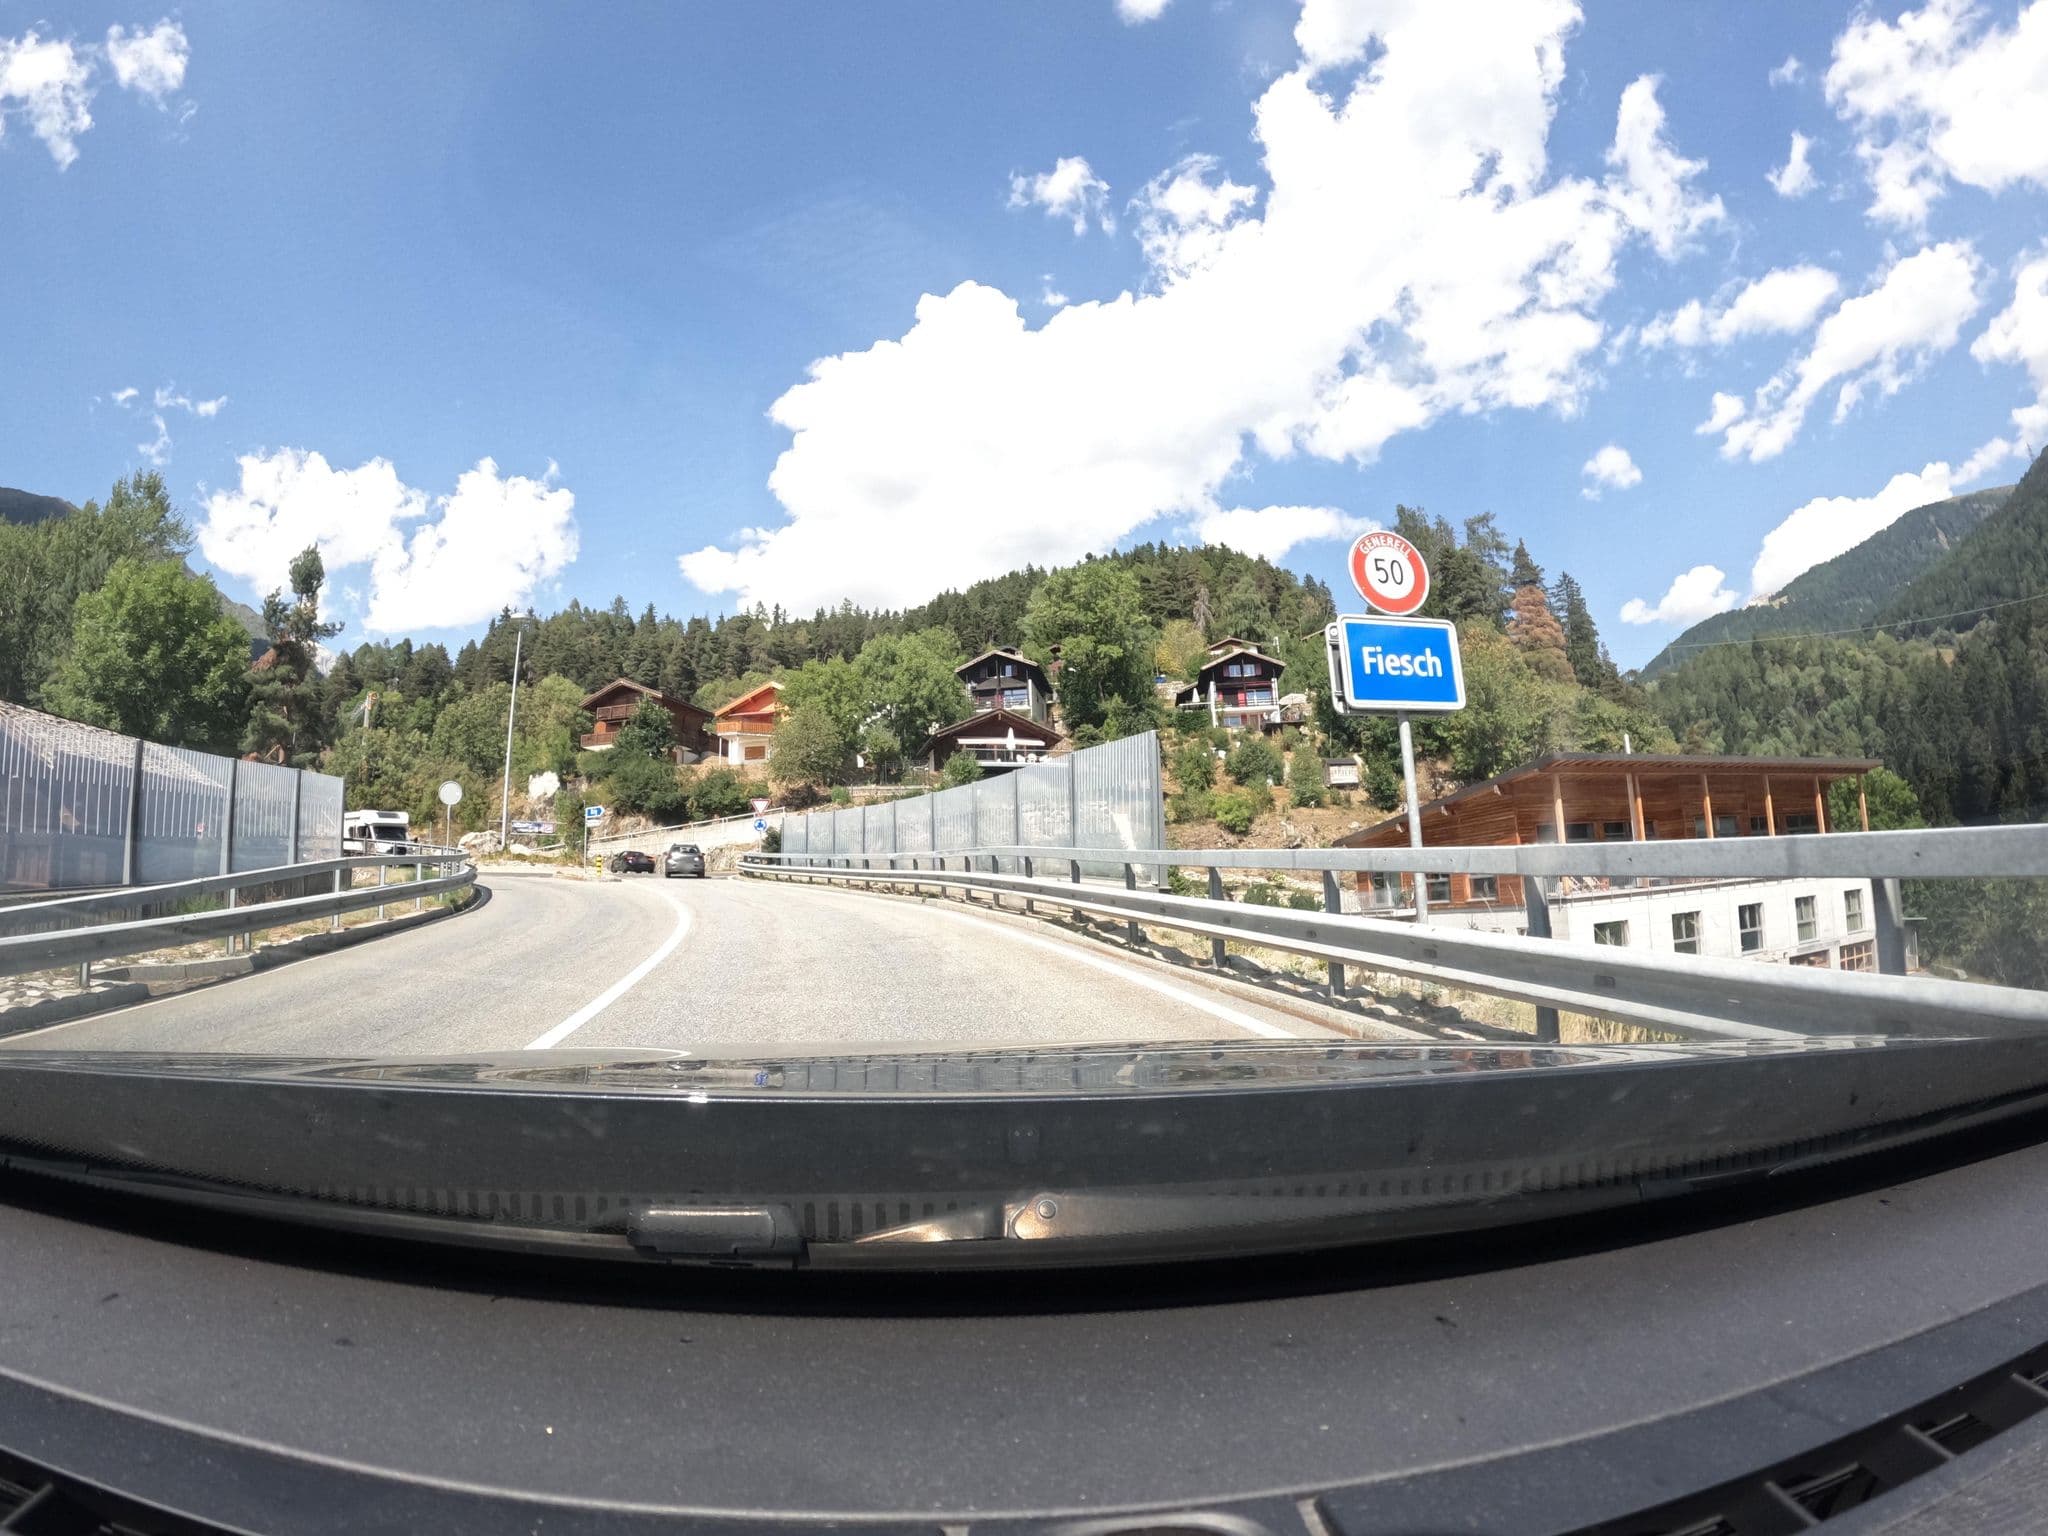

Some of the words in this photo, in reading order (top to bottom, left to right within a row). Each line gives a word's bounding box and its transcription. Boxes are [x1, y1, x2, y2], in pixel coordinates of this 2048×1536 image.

[1360, 537, 1411, 557] GENERELL
[1374, 558, 1404, 586] 50
[1362, 646, 1443, 677] Fiesch
